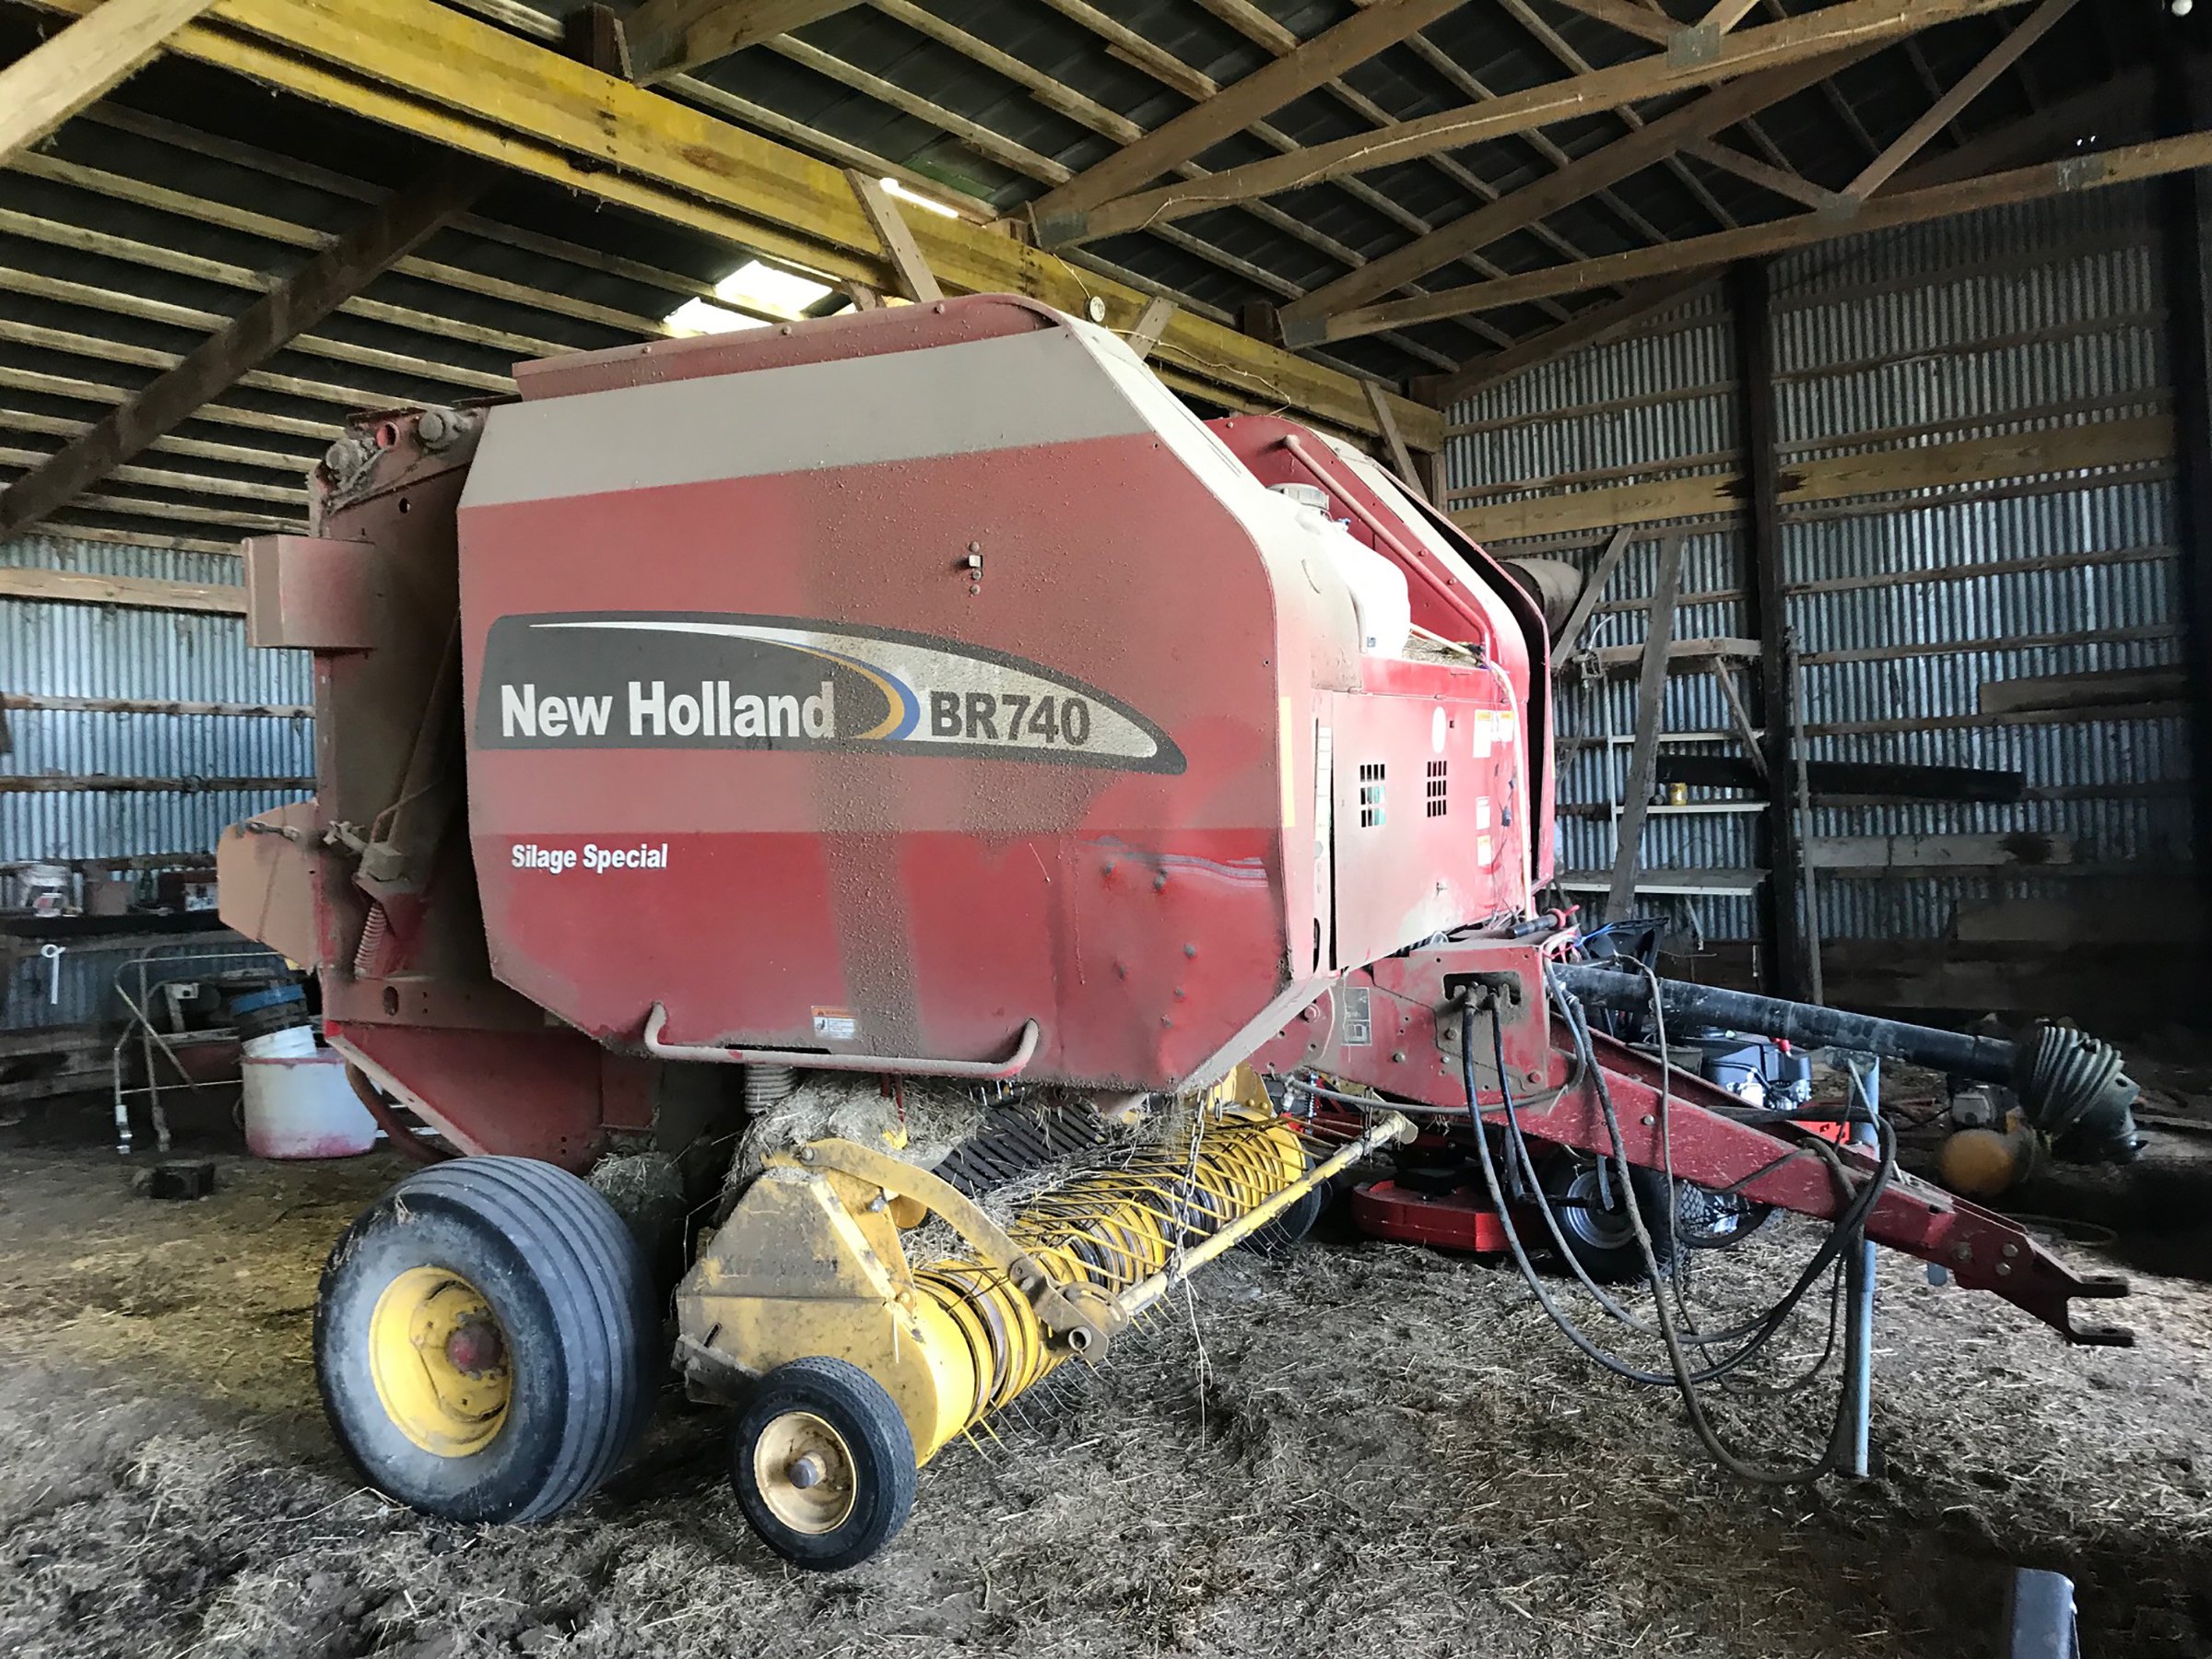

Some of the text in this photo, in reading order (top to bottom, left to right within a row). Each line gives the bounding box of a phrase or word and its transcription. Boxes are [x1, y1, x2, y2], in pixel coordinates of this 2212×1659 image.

[501, 680, 834, 738] New Holland
[930, 690, 1091, 747] BR740
[512, 842, 669, 875] Silage Special
